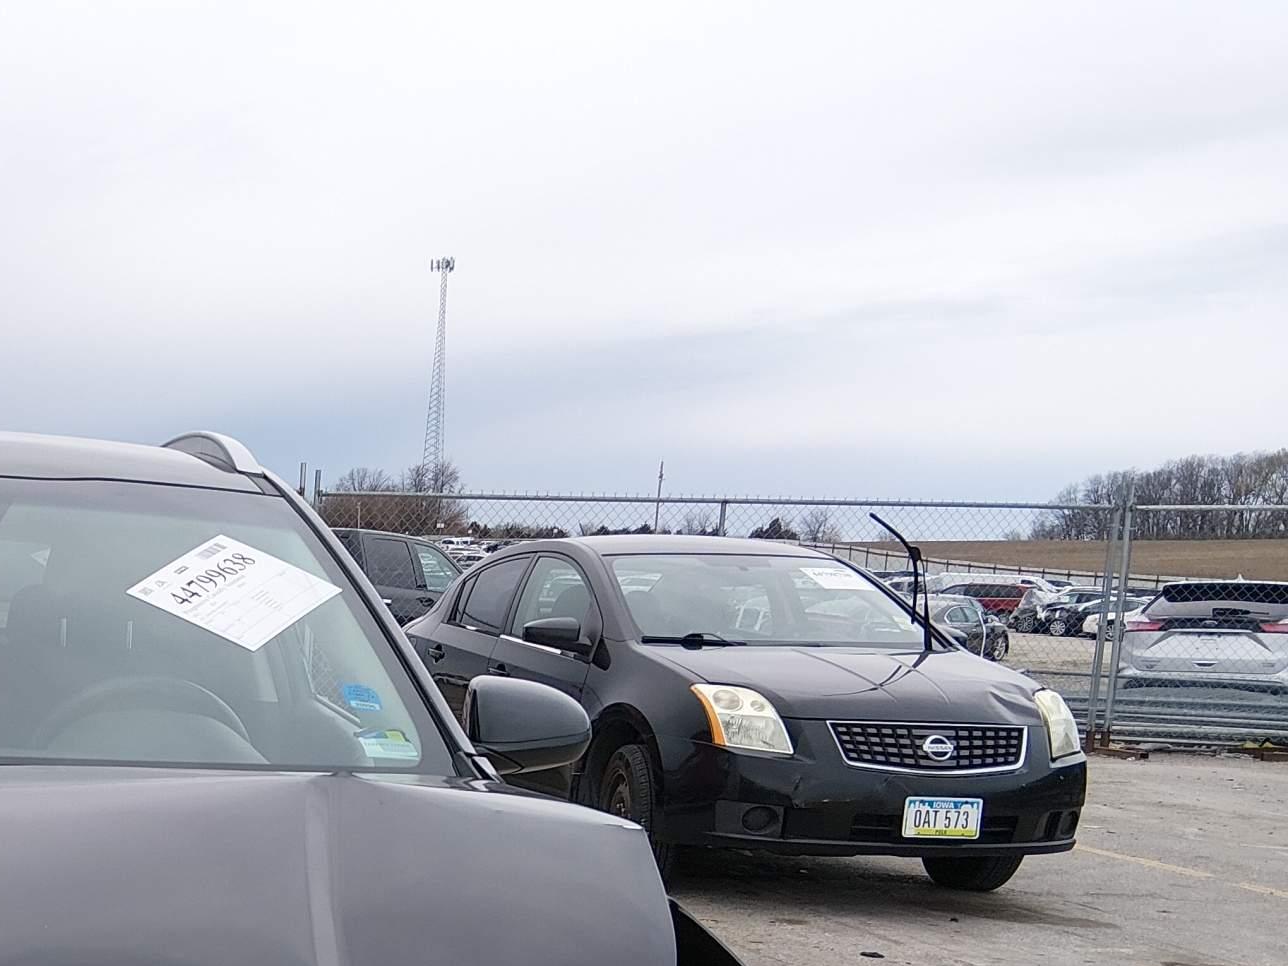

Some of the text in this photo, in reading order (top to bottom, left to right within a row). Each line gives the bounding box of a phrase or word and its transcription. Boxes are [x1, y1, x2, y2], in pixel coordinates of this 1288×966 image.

[170, 552, 256, 607] 44799638
[933, 801, 955, 809] IOWA
[914, 809, 969, 829] OAT 573
